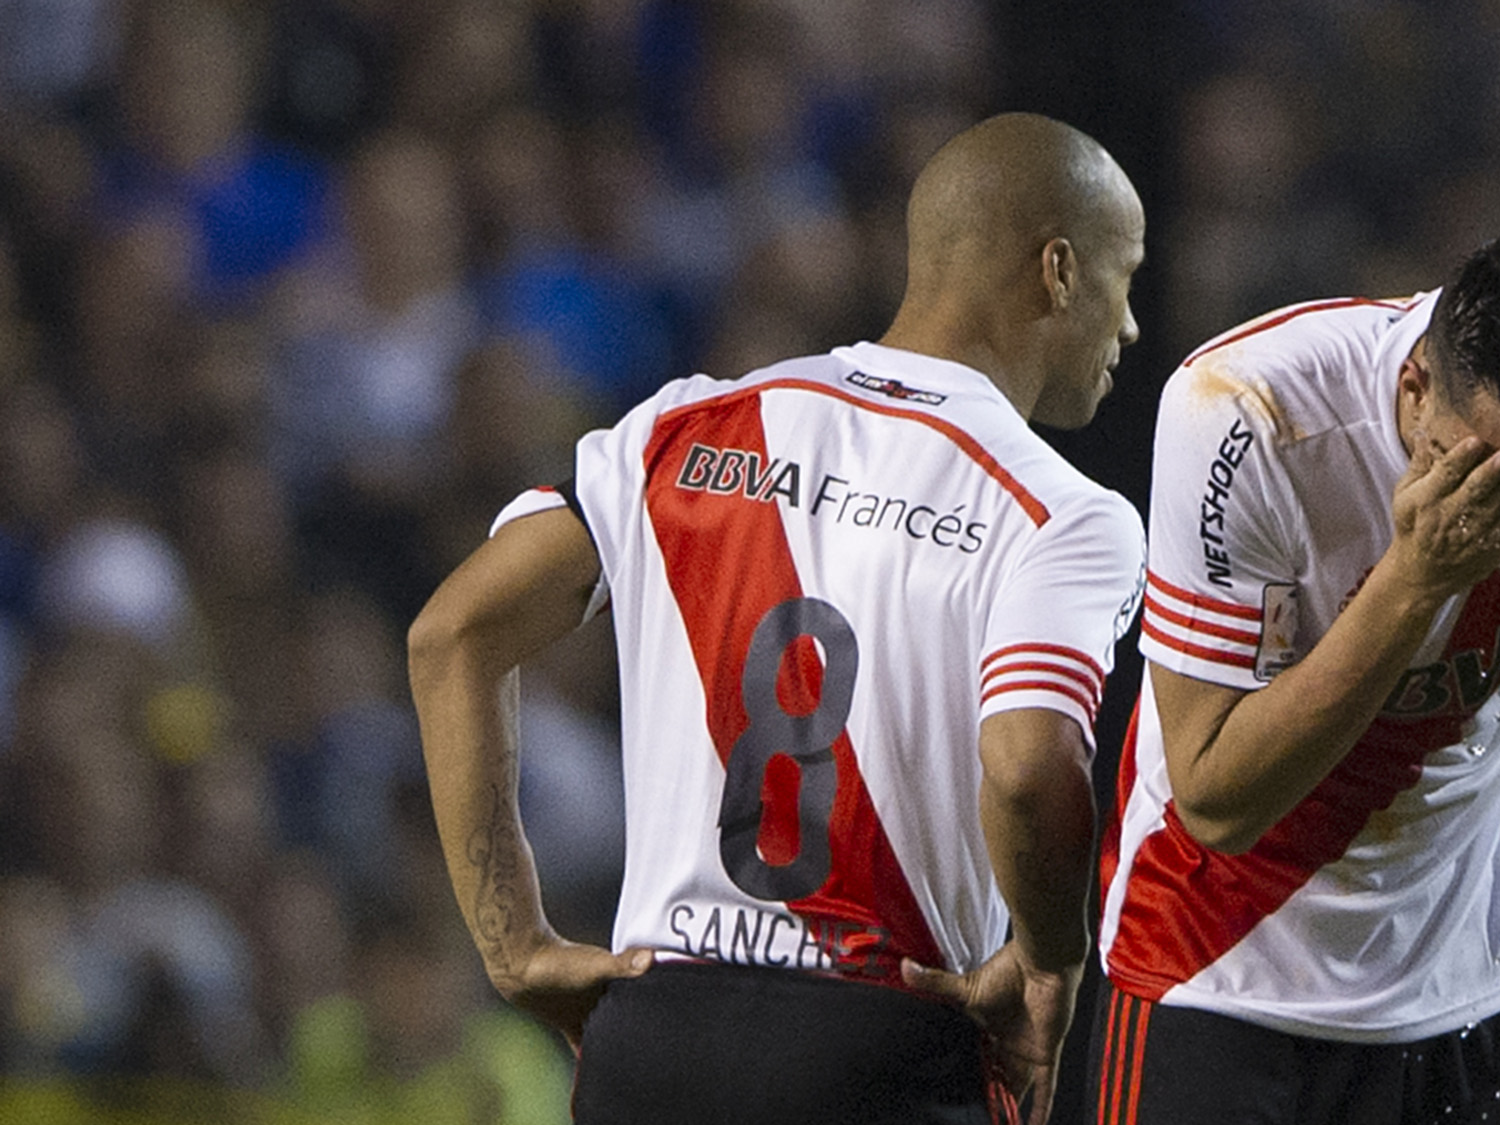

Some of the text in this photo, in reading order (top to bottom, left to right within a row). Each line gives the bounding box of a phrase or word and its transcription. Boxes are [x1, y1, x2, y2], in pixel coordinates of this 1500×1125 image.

[677, 444, 988, 555] BBVA Francés
[1200, 417, 1254, 589] NETSHOES
[719, 597, 859, 902] 8
